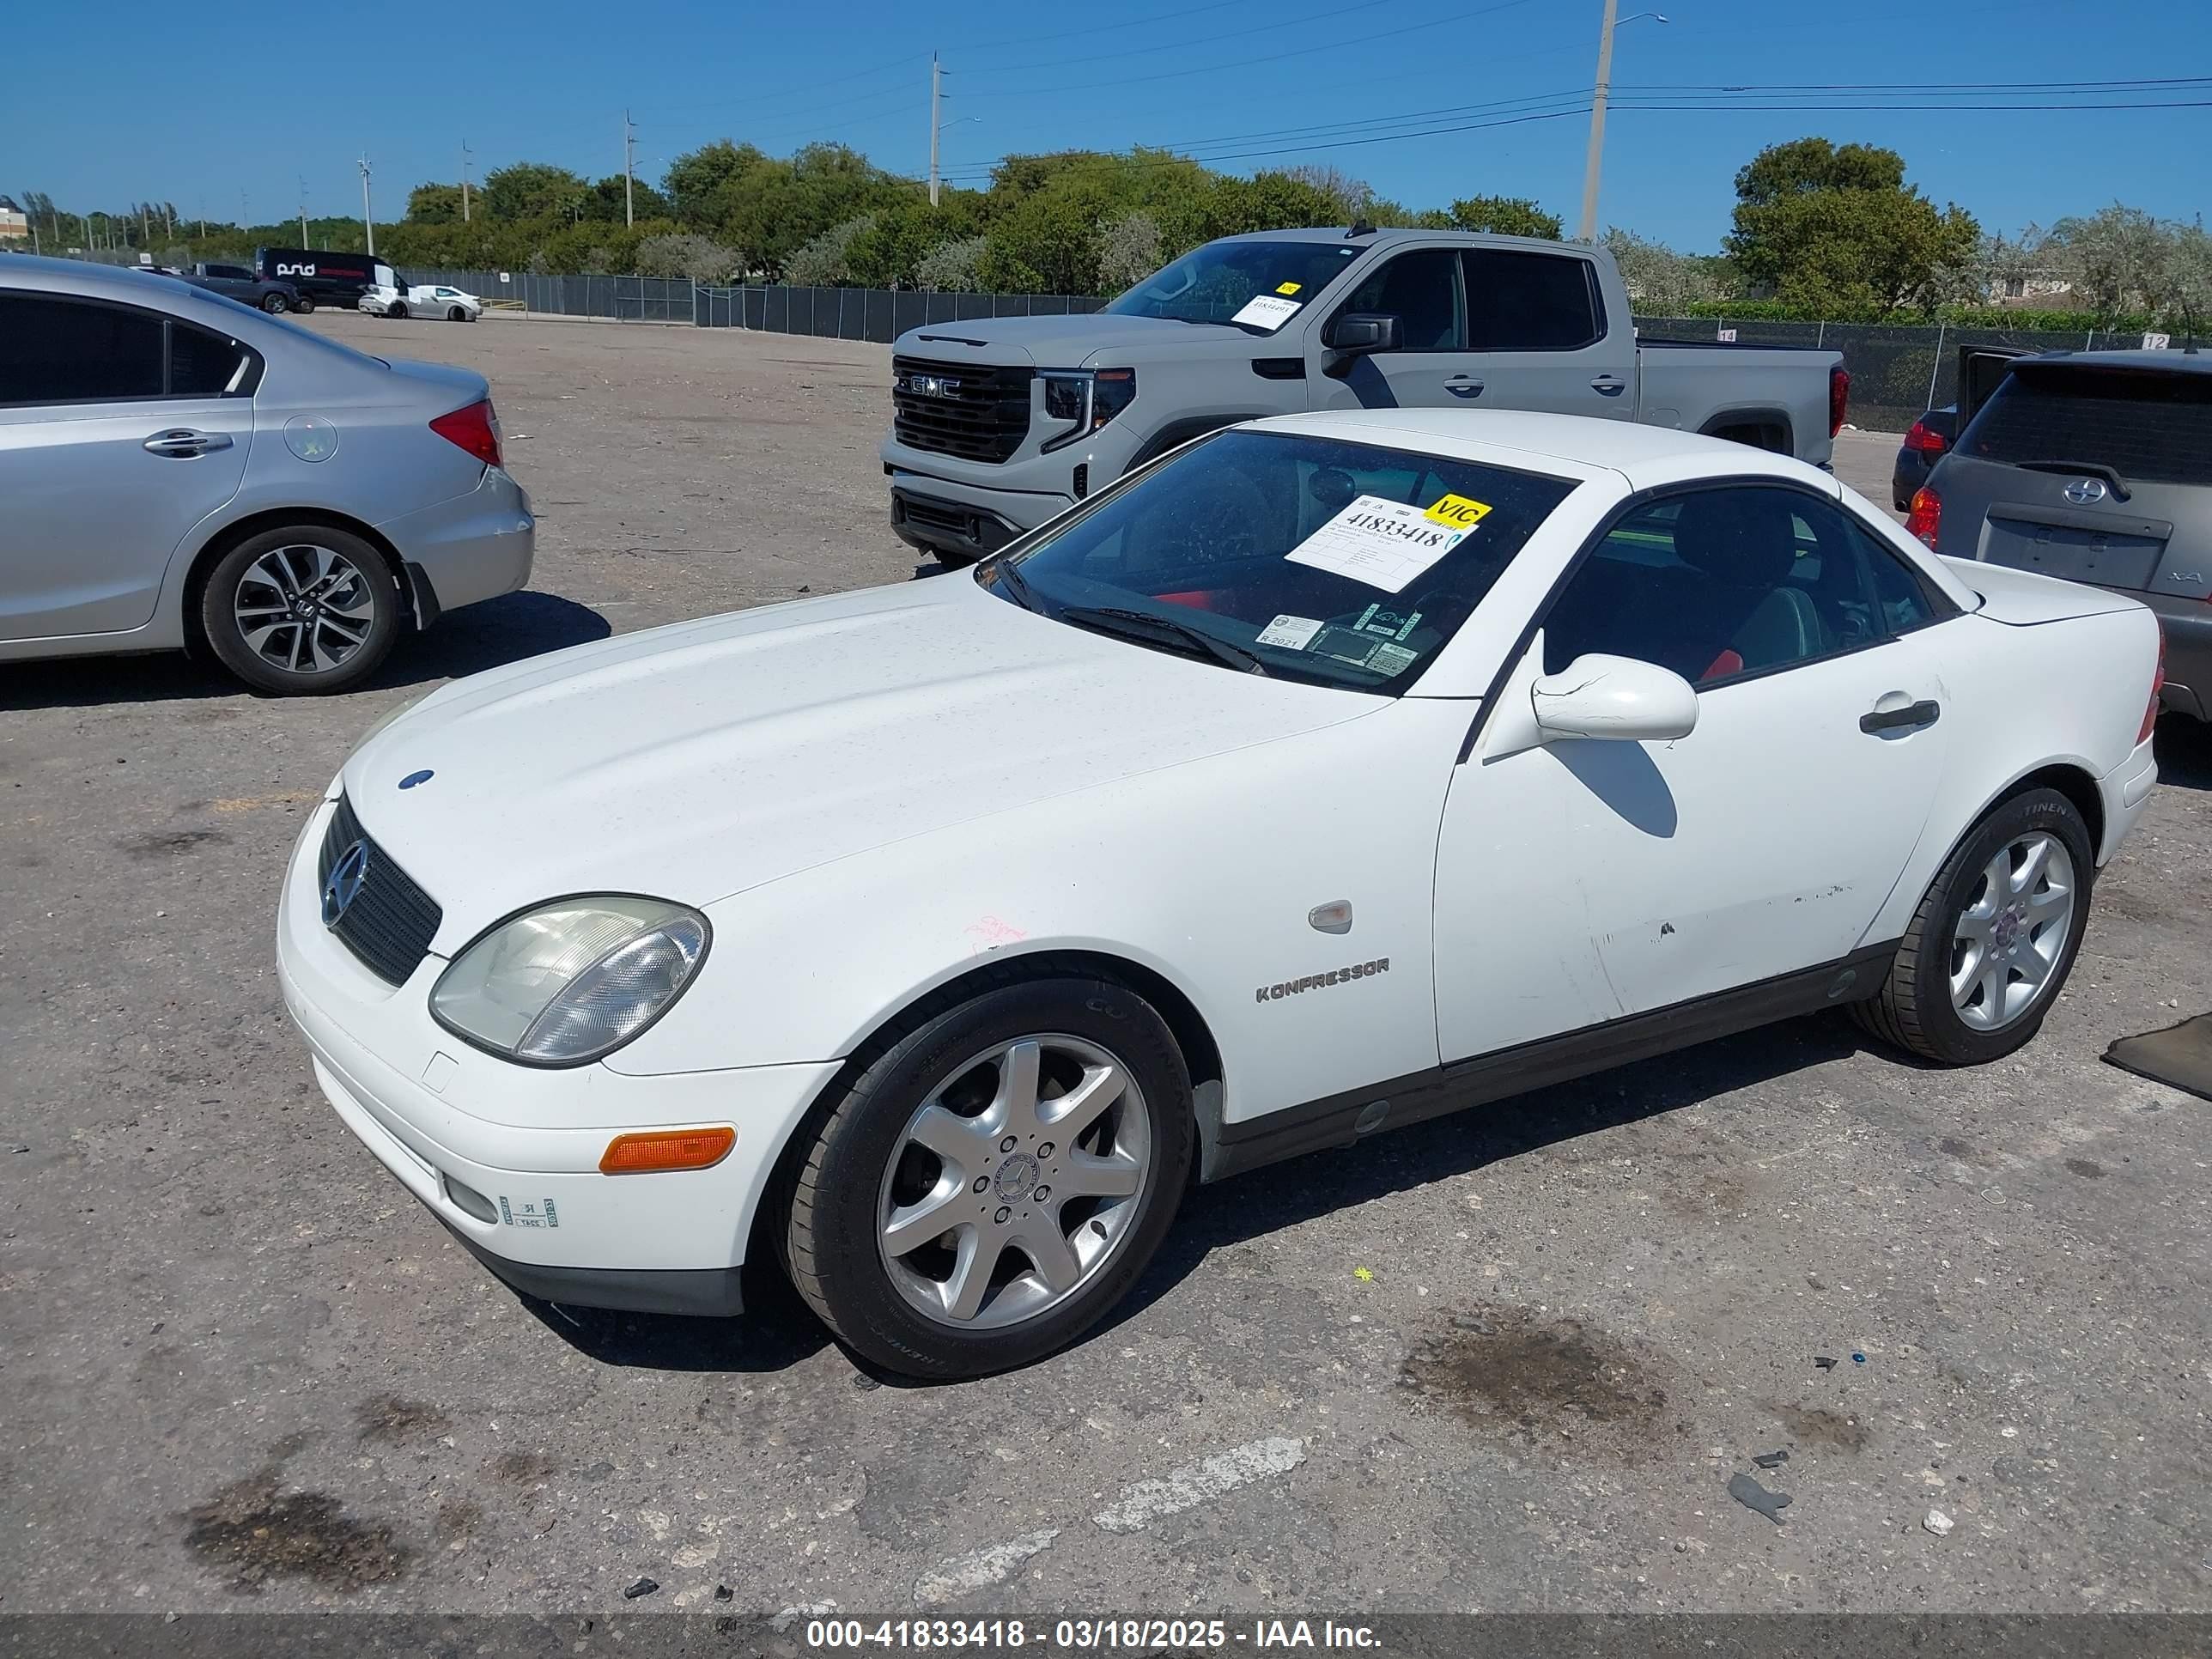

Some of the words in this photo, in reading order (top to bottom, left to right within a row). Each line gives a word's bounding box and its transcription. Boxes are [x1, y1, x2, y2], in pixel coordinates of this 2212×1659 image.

[2147, 336, 2166, 349] 12
[911, 376, 961, 399] GMC
[1437, 501, 1480, 522] VIC
[1346, 513, 1443, 546] 41833418
[1397, 615, 1419, 638] FACULTY
[1260, 635, 1298, 647] R-2021
[1255, 957, 1390, 1003] KOMPRESSOR
